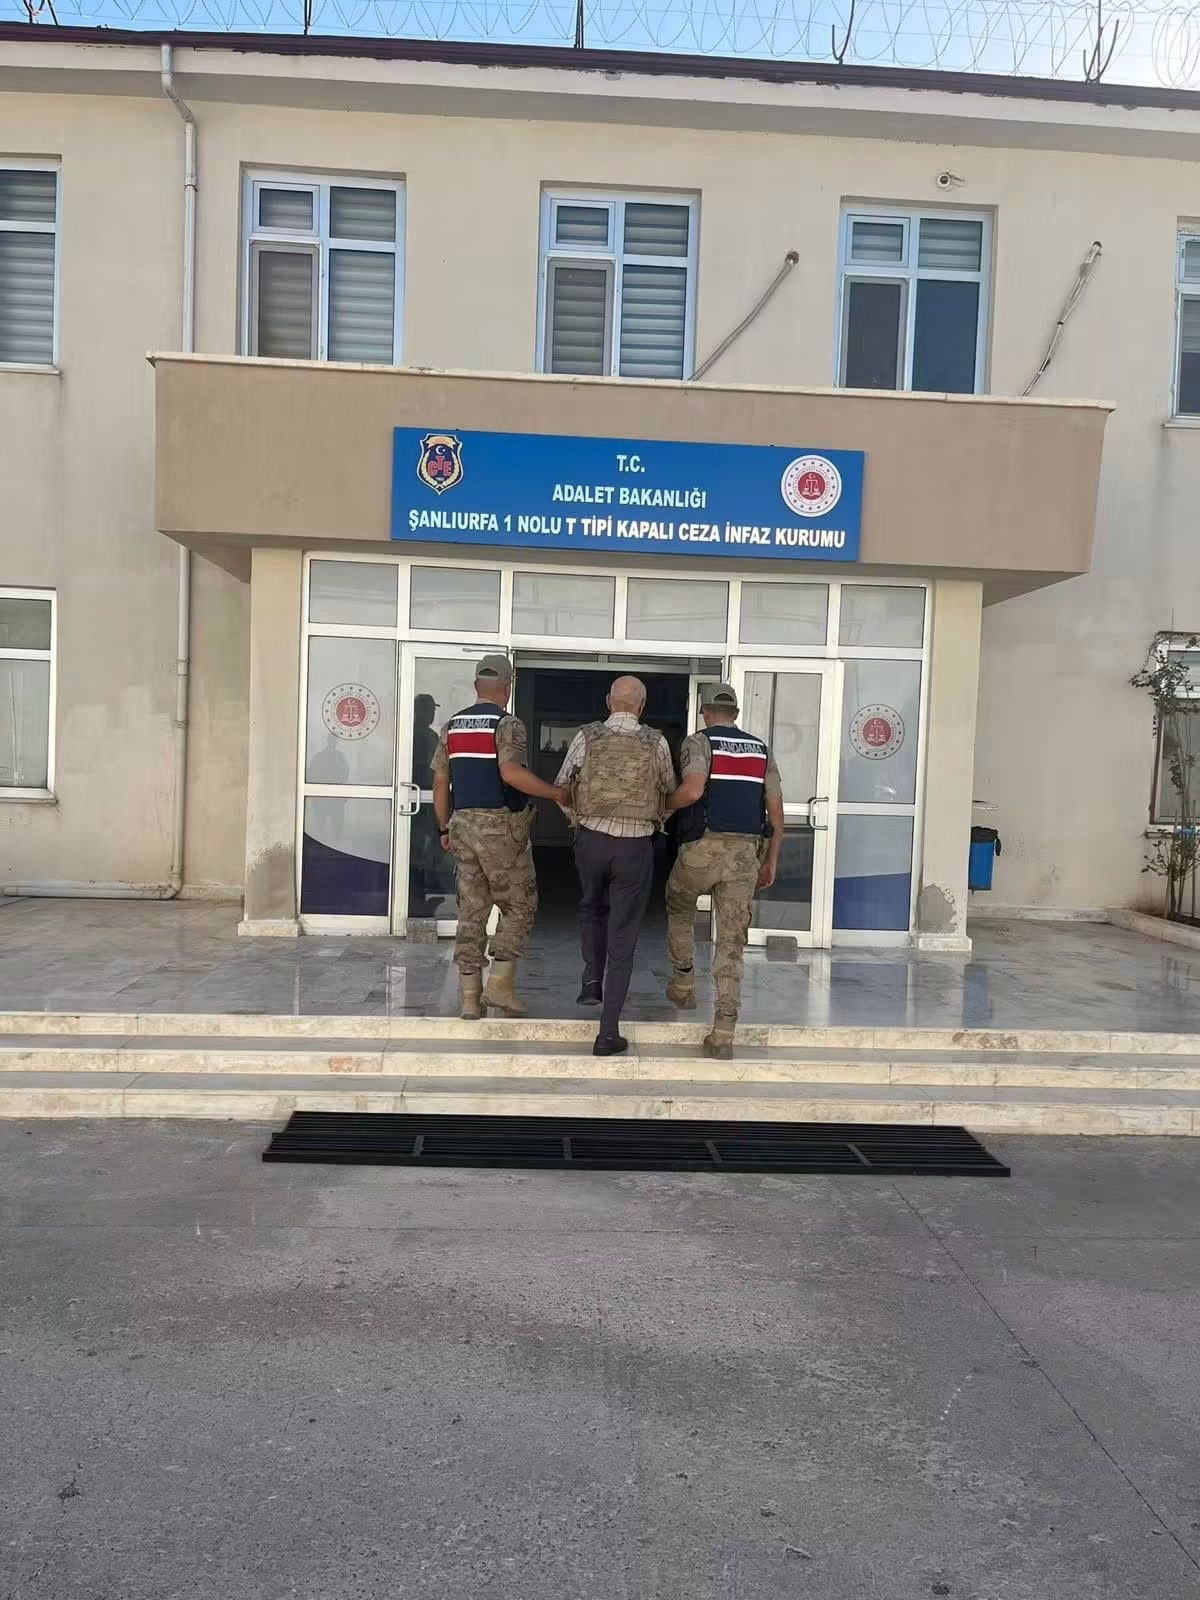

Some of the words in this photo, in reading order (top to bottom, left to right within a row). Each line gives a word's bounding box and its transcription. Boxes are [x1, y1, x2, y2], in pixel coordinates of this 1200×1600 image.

[616, 454, 646, 473] T.C.
[552, 484, 615, 504] ADALET
[619, 487, 706, 509] BAKANLIĞI
[408, 509, 499, 532] ŞANLIURFA
[503, 514, 512, 532] 1
[517, 515, 562, 535] NOLU
[565, 517, 577, 535] T
[580, 515, 613, 537] TİPİ
[616, 520, 674, 540] KAPALI
[678, 523, 721, 543] CEZA
[725, 521, 771, 545] İNFAZ
[775, 527, 846, 549] KURUMU
[719, 740, 763, 754] JANDARMA
